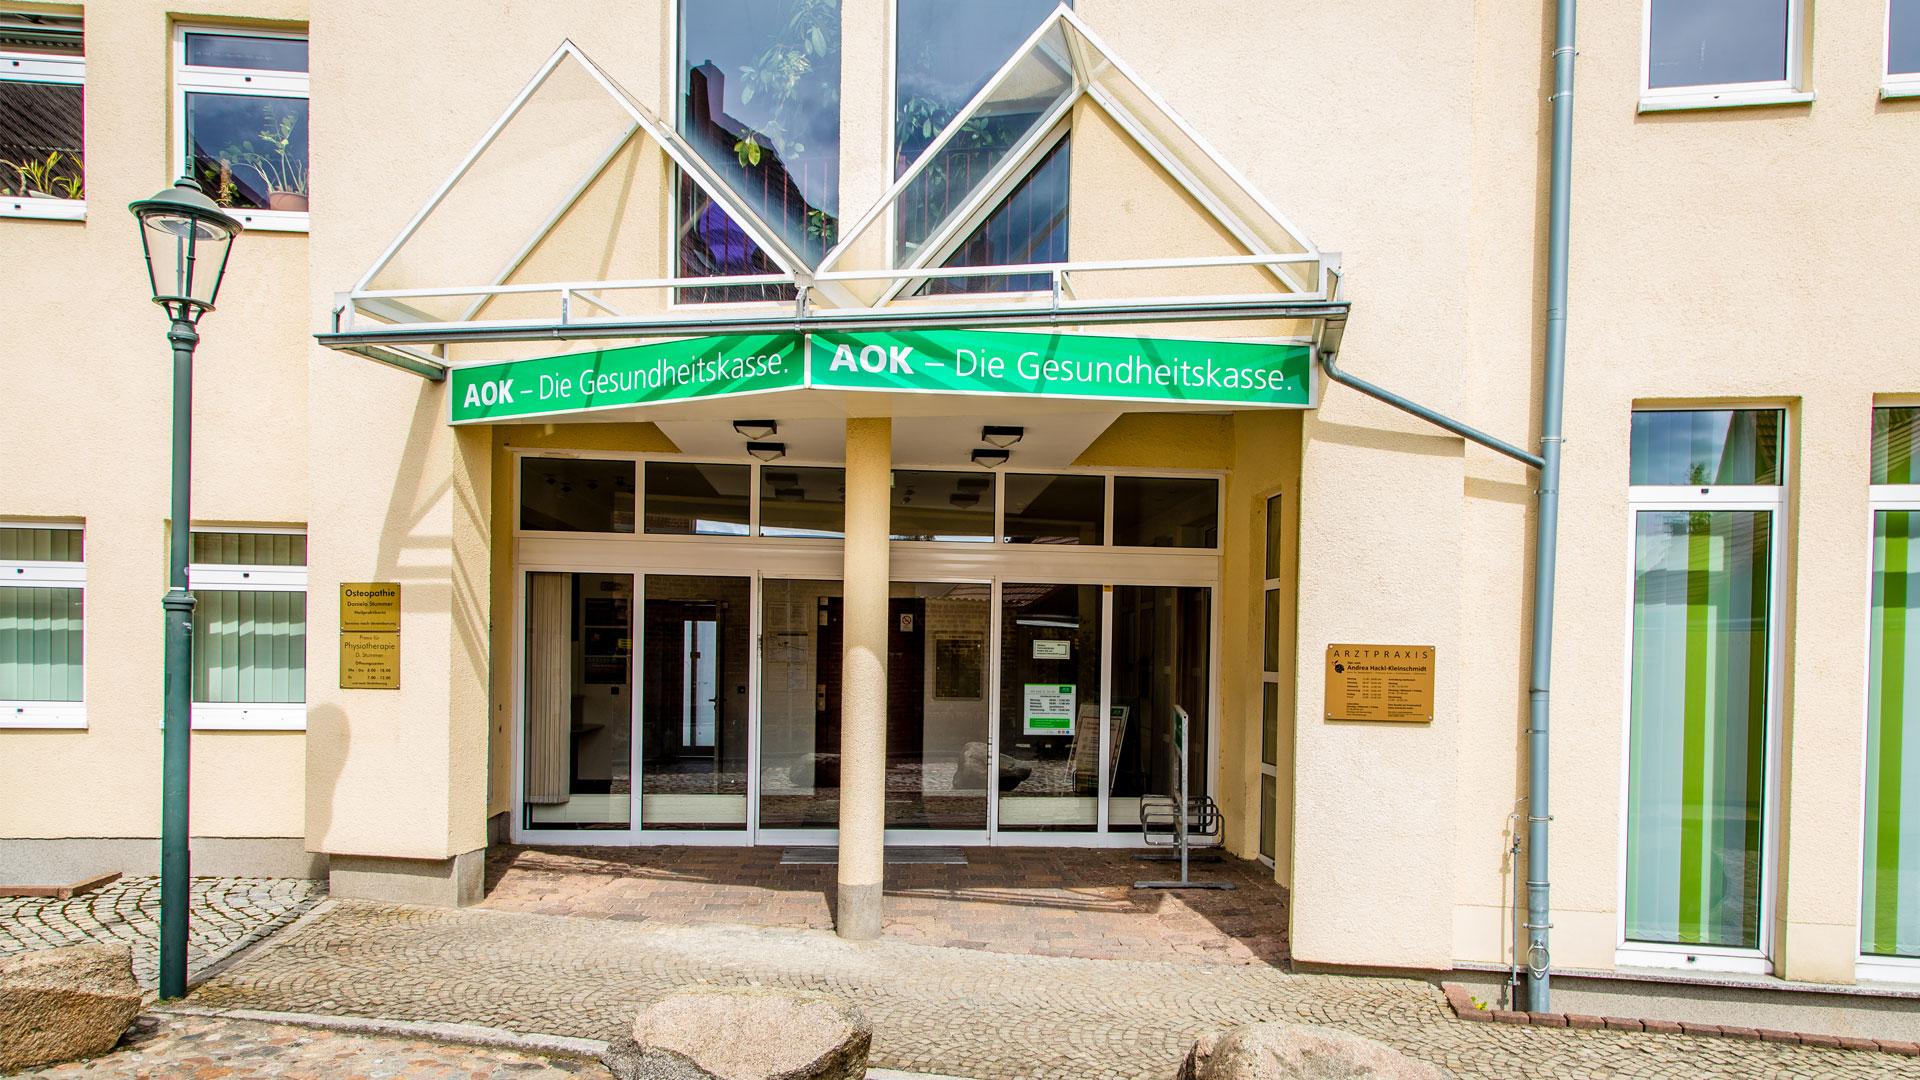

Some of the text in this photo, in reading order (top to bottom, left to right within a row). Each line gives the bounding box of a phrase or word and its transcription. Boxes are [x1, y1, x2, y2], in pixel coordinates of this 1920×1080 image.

[830, 343, 915, 376] AOK
[956, 348, 1004, 379] Die
[1017, 352, 1293, 392] Gesundheitskasse.
[463, 378, 515, 409] AOK
[539, 373, 572, 401] Die
[579, 351, 789, 396] Gesundheitskasse.
[345, 588, 396, 599] Osteopathie
[344, 641, 396, 651] Physiotherapie
[1333, 649, 1428, 660] ARZTPRAXIS
[1369, 664, 1427, 672] Hackl-Kleinschmidt
